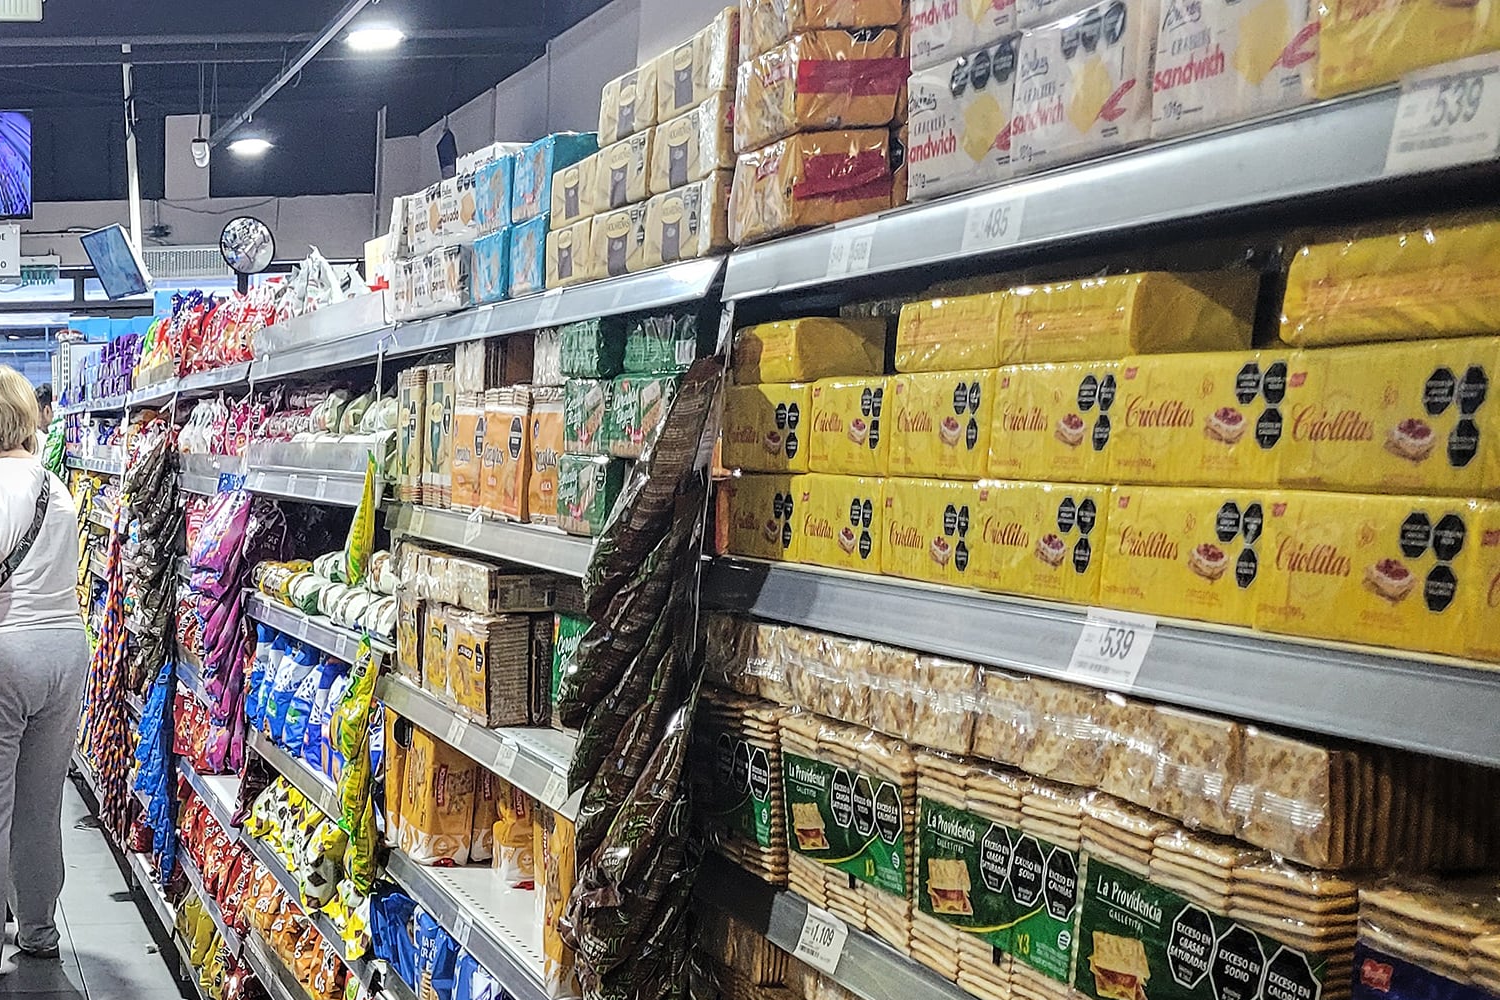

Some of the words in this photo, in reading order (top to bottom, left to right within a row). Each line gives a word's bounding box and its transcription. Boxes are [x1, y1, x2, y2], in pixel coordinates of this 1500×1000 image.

[1153, 45, 1225, 93] sandwich
[1012, 98, 1064, 136] sandwich
[1125, 395, 1195, 428] Criollitas
[1292, 404, 1374, 442] Criollitas
[889, 523, 924, 550] Criollitas
[982, 516, 1029, 547] Criollitas
[1119, 524, 1179, 560] Criollitas
[1276, 532, 1350, 577] Criollitas
[1100, 628, 1135, 660] 539
[928, 810, 937, 828] La
[937, 815, 976, 843] Providencia
[985, 839, 1001, 852] EXCESO
[1015, 856, 1033, 870] EXCESO
[1049, 870, 1066, 885] EXCESO
[1067, 878, 1075, 889] EN
[1097, 875, 1109, 895] La
[1111, 887, 1163, 924] Providencia
[1109, 910, 1144, 934] GALLETITAS
[1177, 922, 1200, 940] EXCESO
[1200, 932, 1212, 946] EN
[1170, 946, 1208, 971] SATURADAS
[1179, 937, 1204, 955] GRASAS
[1219, 949, 1248, 969] EXCESO
[1249, 963, 1260, 975] EN
[1224, 965, 1250, 983] SODIO
[1269, 972, 1297, 992] EXCESO
[1298, 987, 1310, 999] EN
